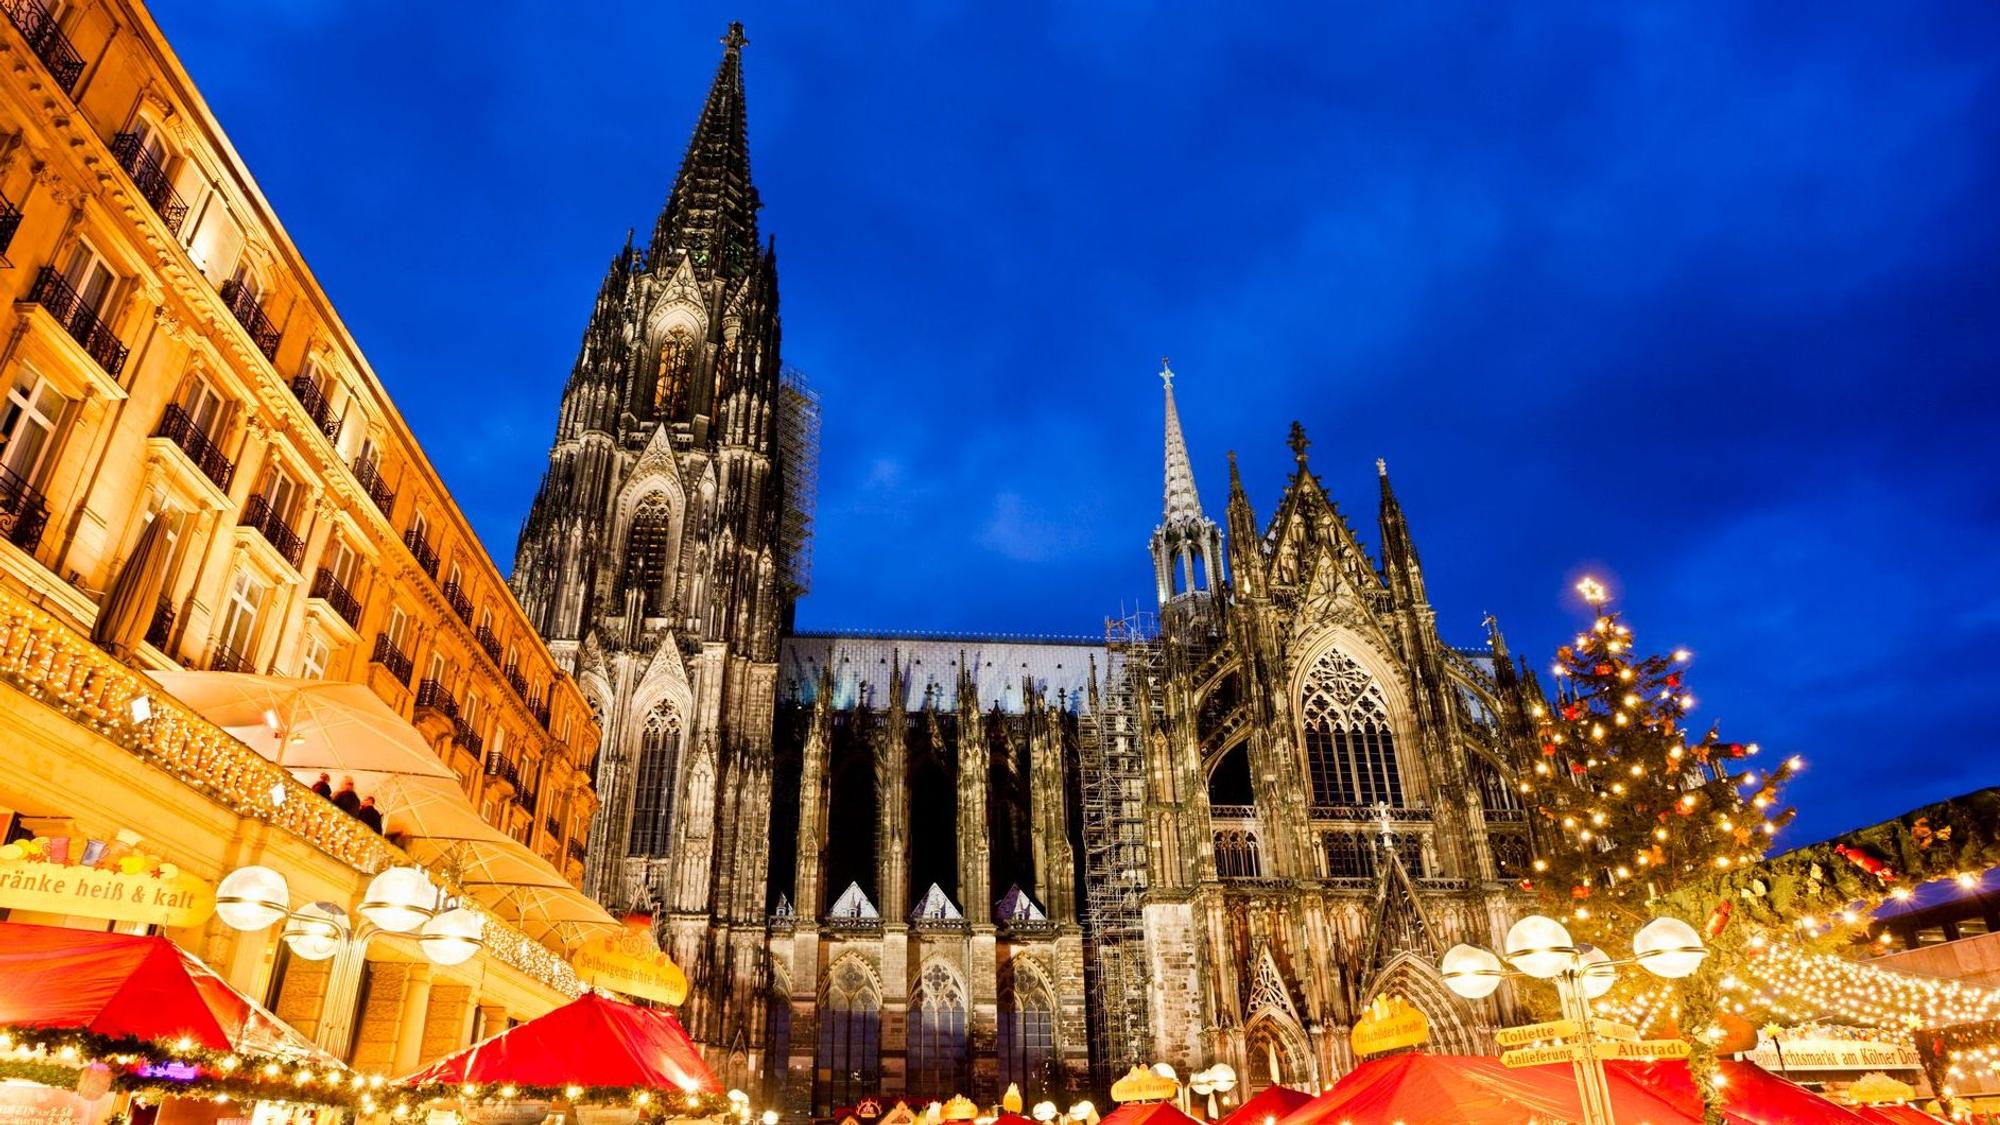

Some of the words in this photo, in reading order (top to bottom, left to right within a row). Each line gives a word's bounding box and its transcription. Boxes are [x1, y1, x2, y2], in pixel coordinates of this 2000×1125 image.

[76, 878, 124, 901] heiß
[132, 885, 146, 904] &
[153, 888, 195, 909] kalt
[1501, 1026, 1555, 1044] Toilette
[1507, 1049, 1572, 1067] Anlieferung
[1618, 1043, 1685, 1057] Altstadt
[1842, 1053, 1858, 1065] am
[1860, 1047, 1897, 1065] Kölner
